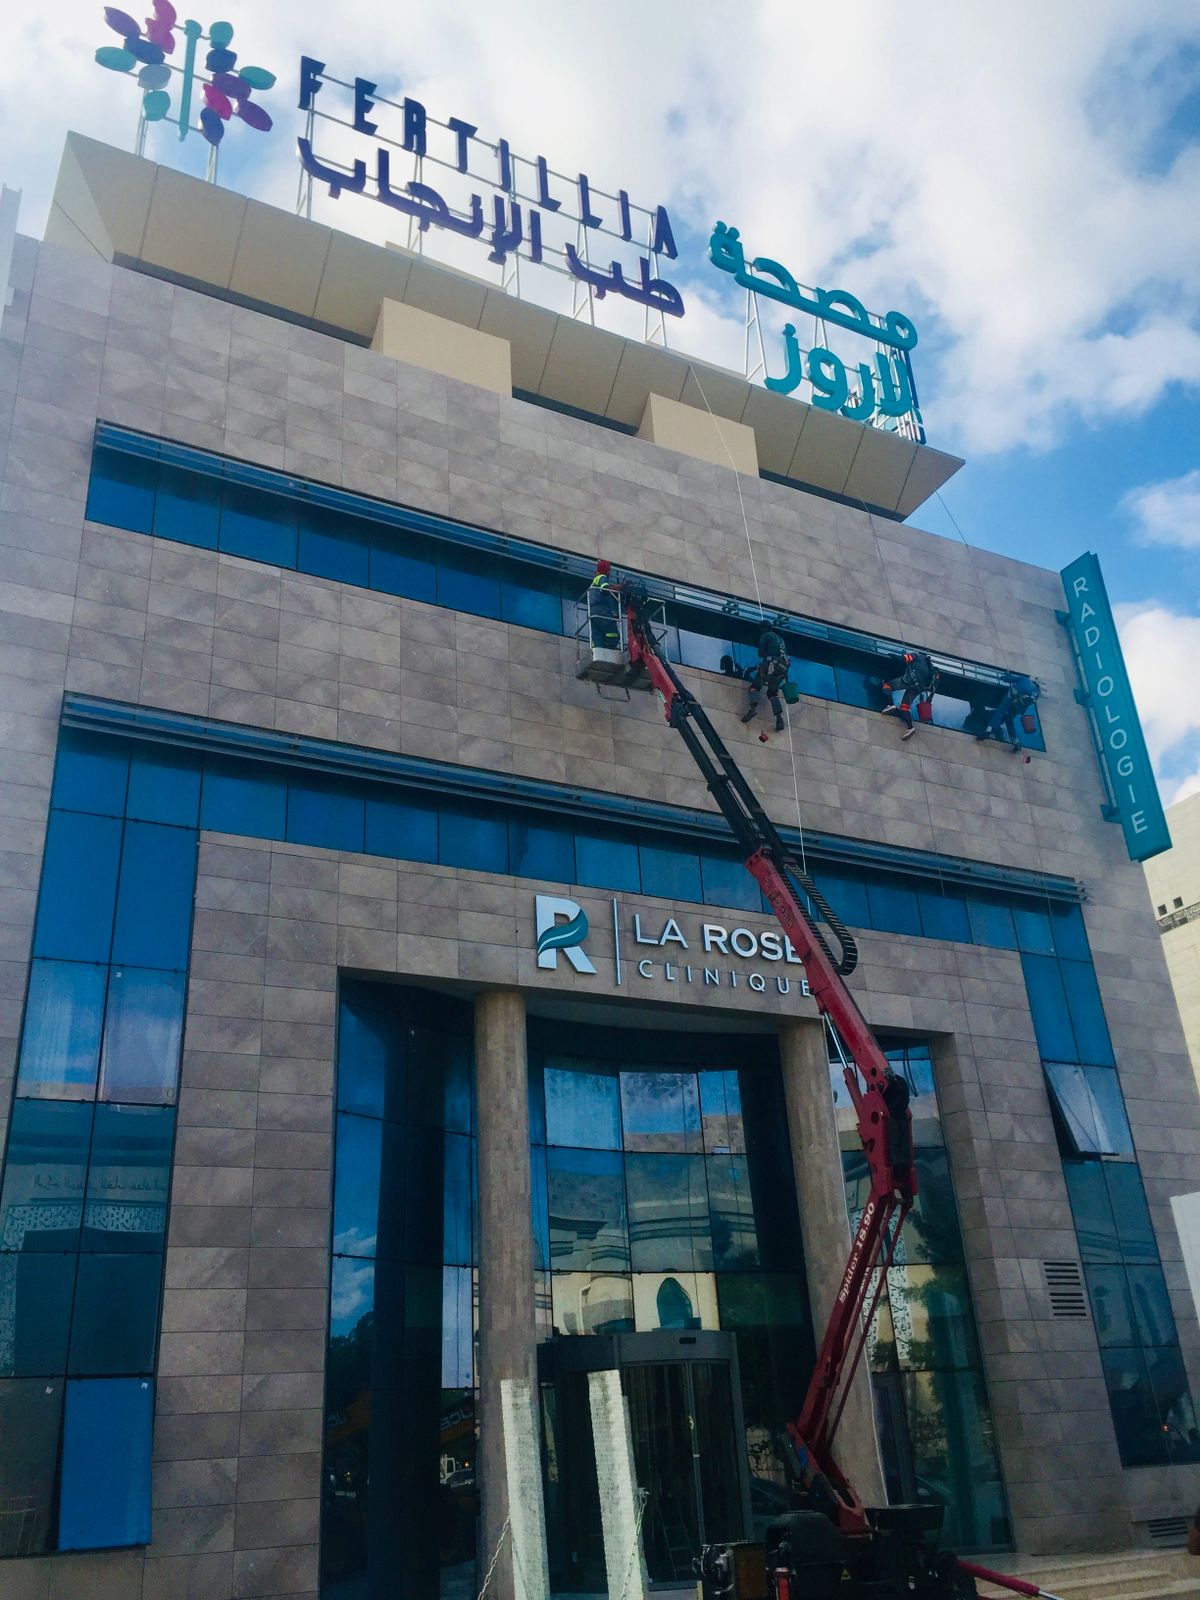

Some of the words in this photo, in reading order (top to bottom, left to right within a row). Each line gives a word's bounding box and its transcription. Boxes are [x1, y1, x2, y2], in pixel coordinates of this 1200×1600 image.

[296, 136, 542, 265] الإنجاب
[298, 55, 678, 260] FERTILLIA
[565, 243, 685, 318] طب
[709, 220, 918, 351] مصحة
[764, 323, 913, 421] لاروز
[1073, 576, 1148, 834] RADIOLOGIE
[634, 913, 689, 950] LA
[638, 960, 812, 998] CLINIQUE
[839, 1253, 858, 1304] Spider
